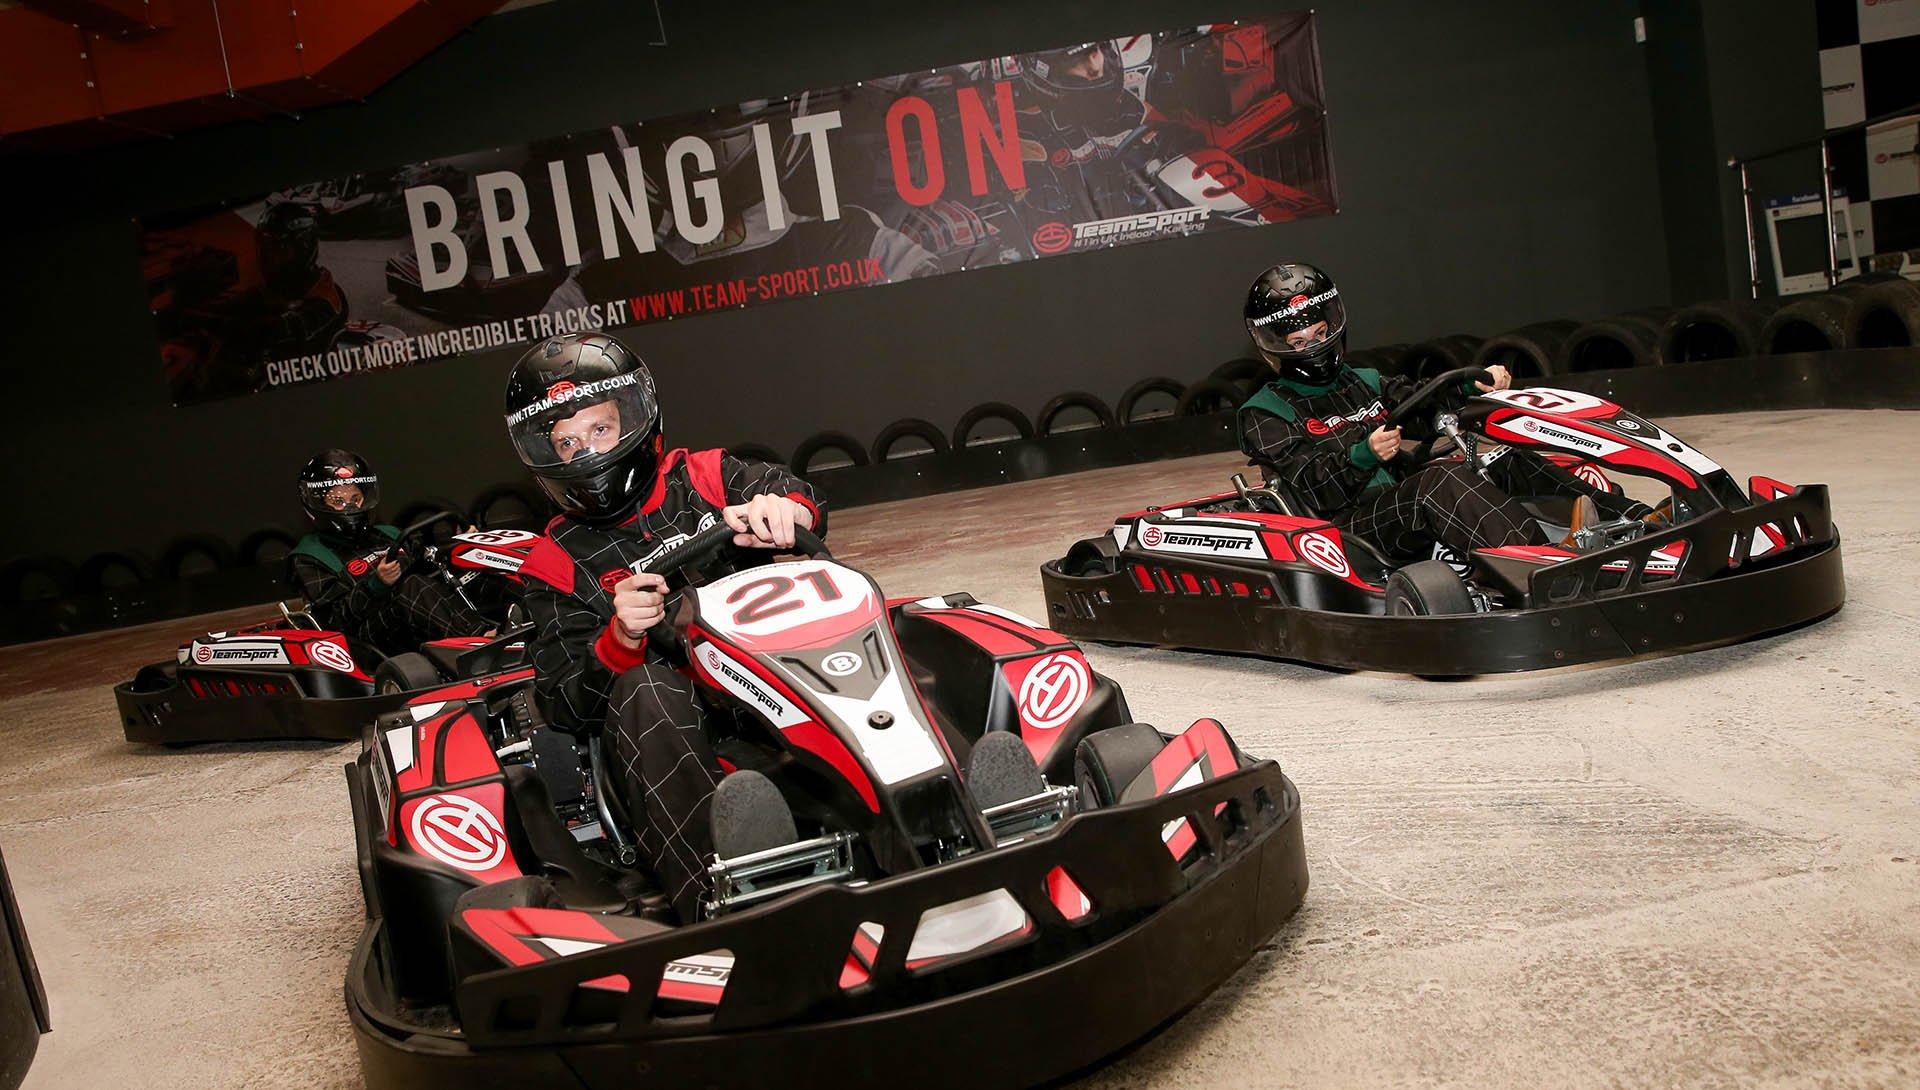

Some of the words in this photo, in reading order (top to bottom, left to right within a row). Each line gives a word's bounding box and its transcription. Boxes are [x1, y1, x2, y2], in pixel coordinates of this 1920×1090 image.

[404, 136, 724, 293] BRING
[753, 111, 841, 231] IT
[886, 81, 1026, 206] ON
[1192, 160, 1246, 198] 3
[1072, 205, 1212, 239] TeamSport
[1100, 233, 1118, 244] UK
[1120, 229, 1155, 242] Indoor
[266, 356, 326, 386] CHECK
[329, 347, 361, 376] OUT
[364, 337, 417, 369] MORE
[417, 321, 527, 358] INCREDIBLE
[526, 303, 604, 340] TRACKS
[606, 300, 628, 326] AT
[630, 256, 886, 321] WWW.TEAM-SPORT.CO.UK
[1506, 391, 1577, 409] 21
[1537, 426, 1603, 451] TeamSport
[1163, 530, 1253, 551] TeamSport
[726, 568, 843, 625] 21
[211, 648, 280, 660] TeamSport
[720, 661, 785, 717] TeamSport
